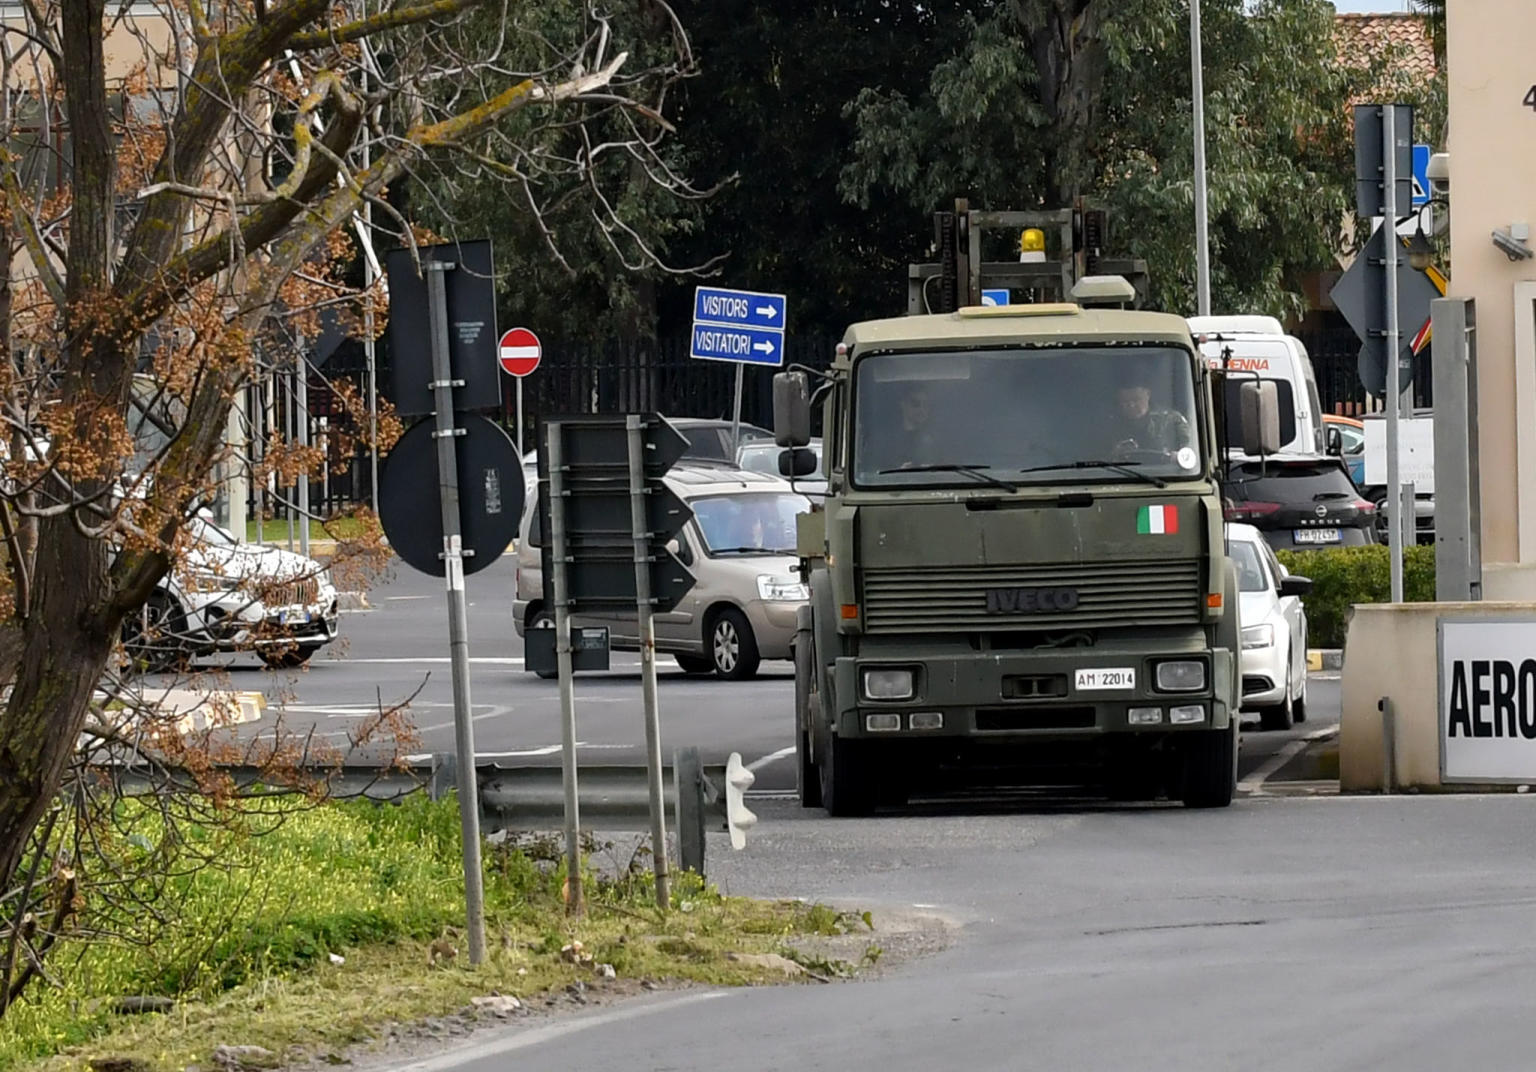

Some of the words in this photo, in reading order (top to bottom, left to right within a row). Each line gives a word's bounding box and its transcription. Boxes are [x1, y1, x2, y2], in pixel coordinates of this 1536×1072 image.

[702, 295, 748, 318] VISITORS
[695, 330, 751, 355] VISITATORI
[985, 589, 1079, 613] IVECO
[1078, 673, 1096, 686] AM
[1102, 672, 1133, 685] 22014
